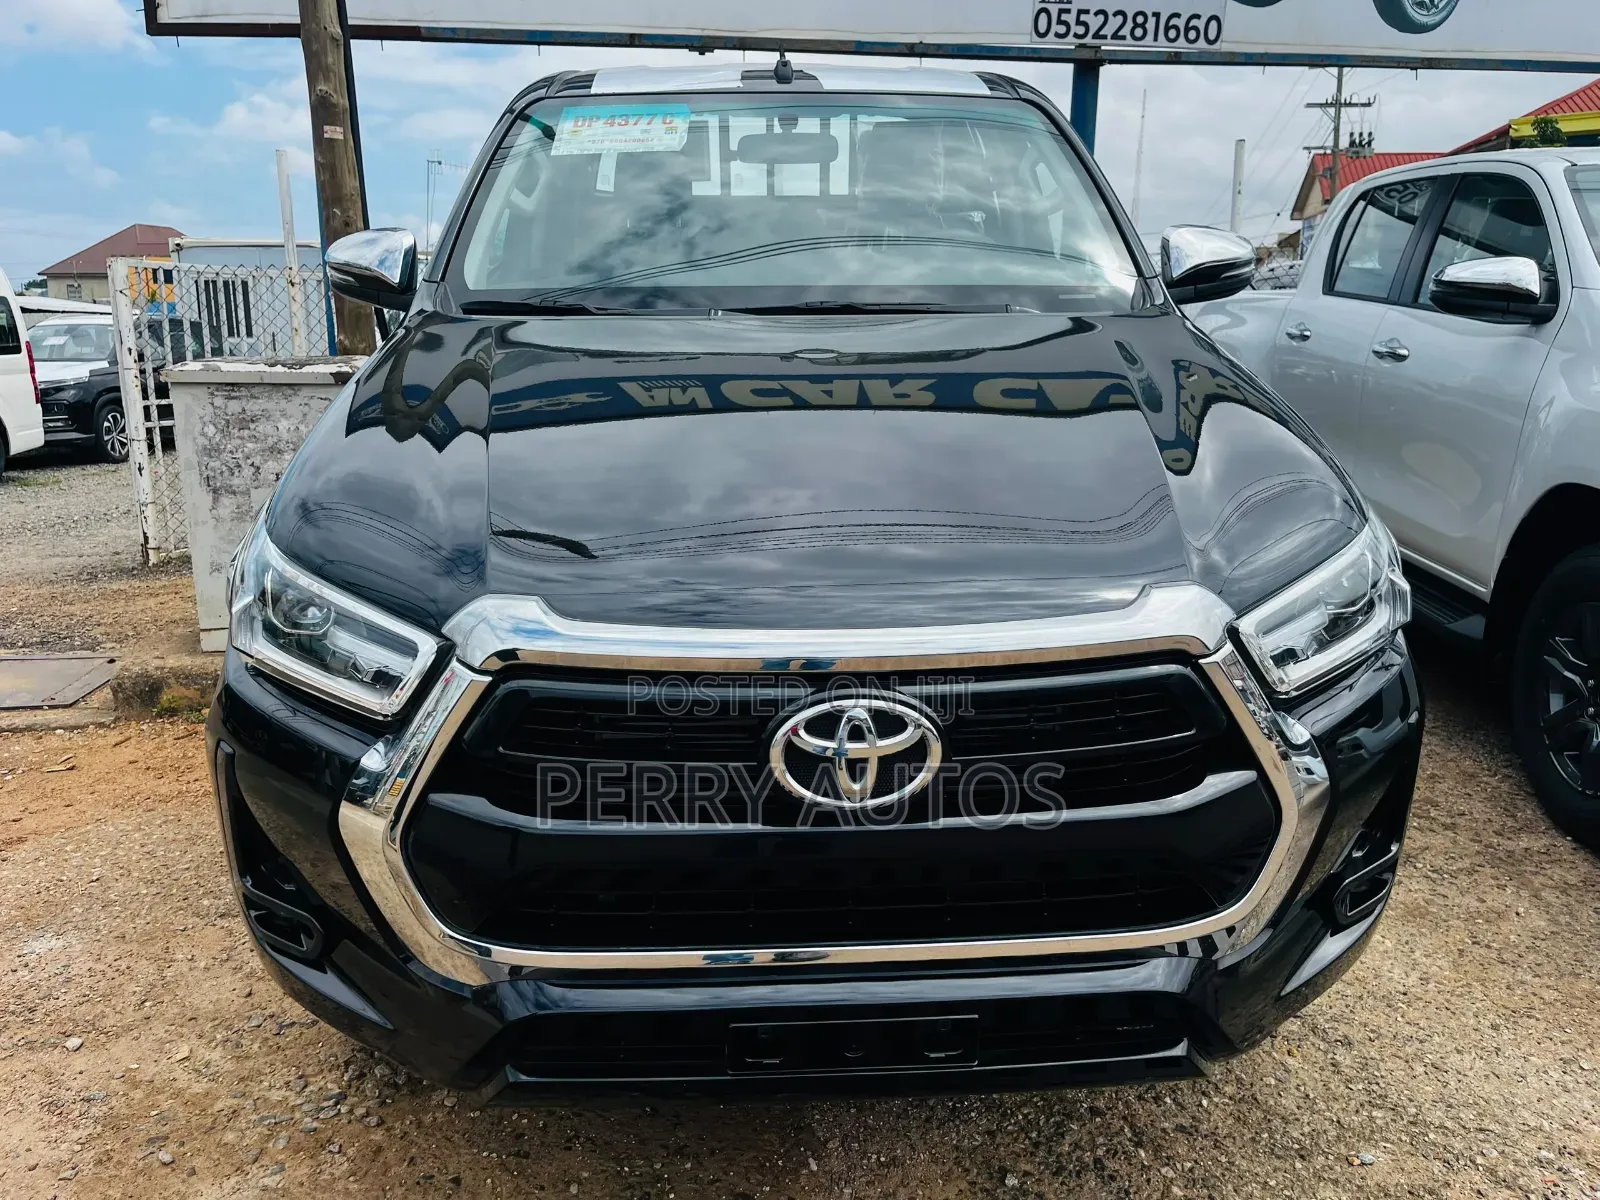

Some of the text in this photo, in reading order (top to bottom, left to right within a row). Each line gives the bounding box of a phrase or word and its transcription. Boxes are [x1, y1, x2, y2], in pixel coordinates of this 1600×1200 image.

[1033, 7, 1222, 46] 0552281660
[572, 112, 675, 129] DP 4377 C
